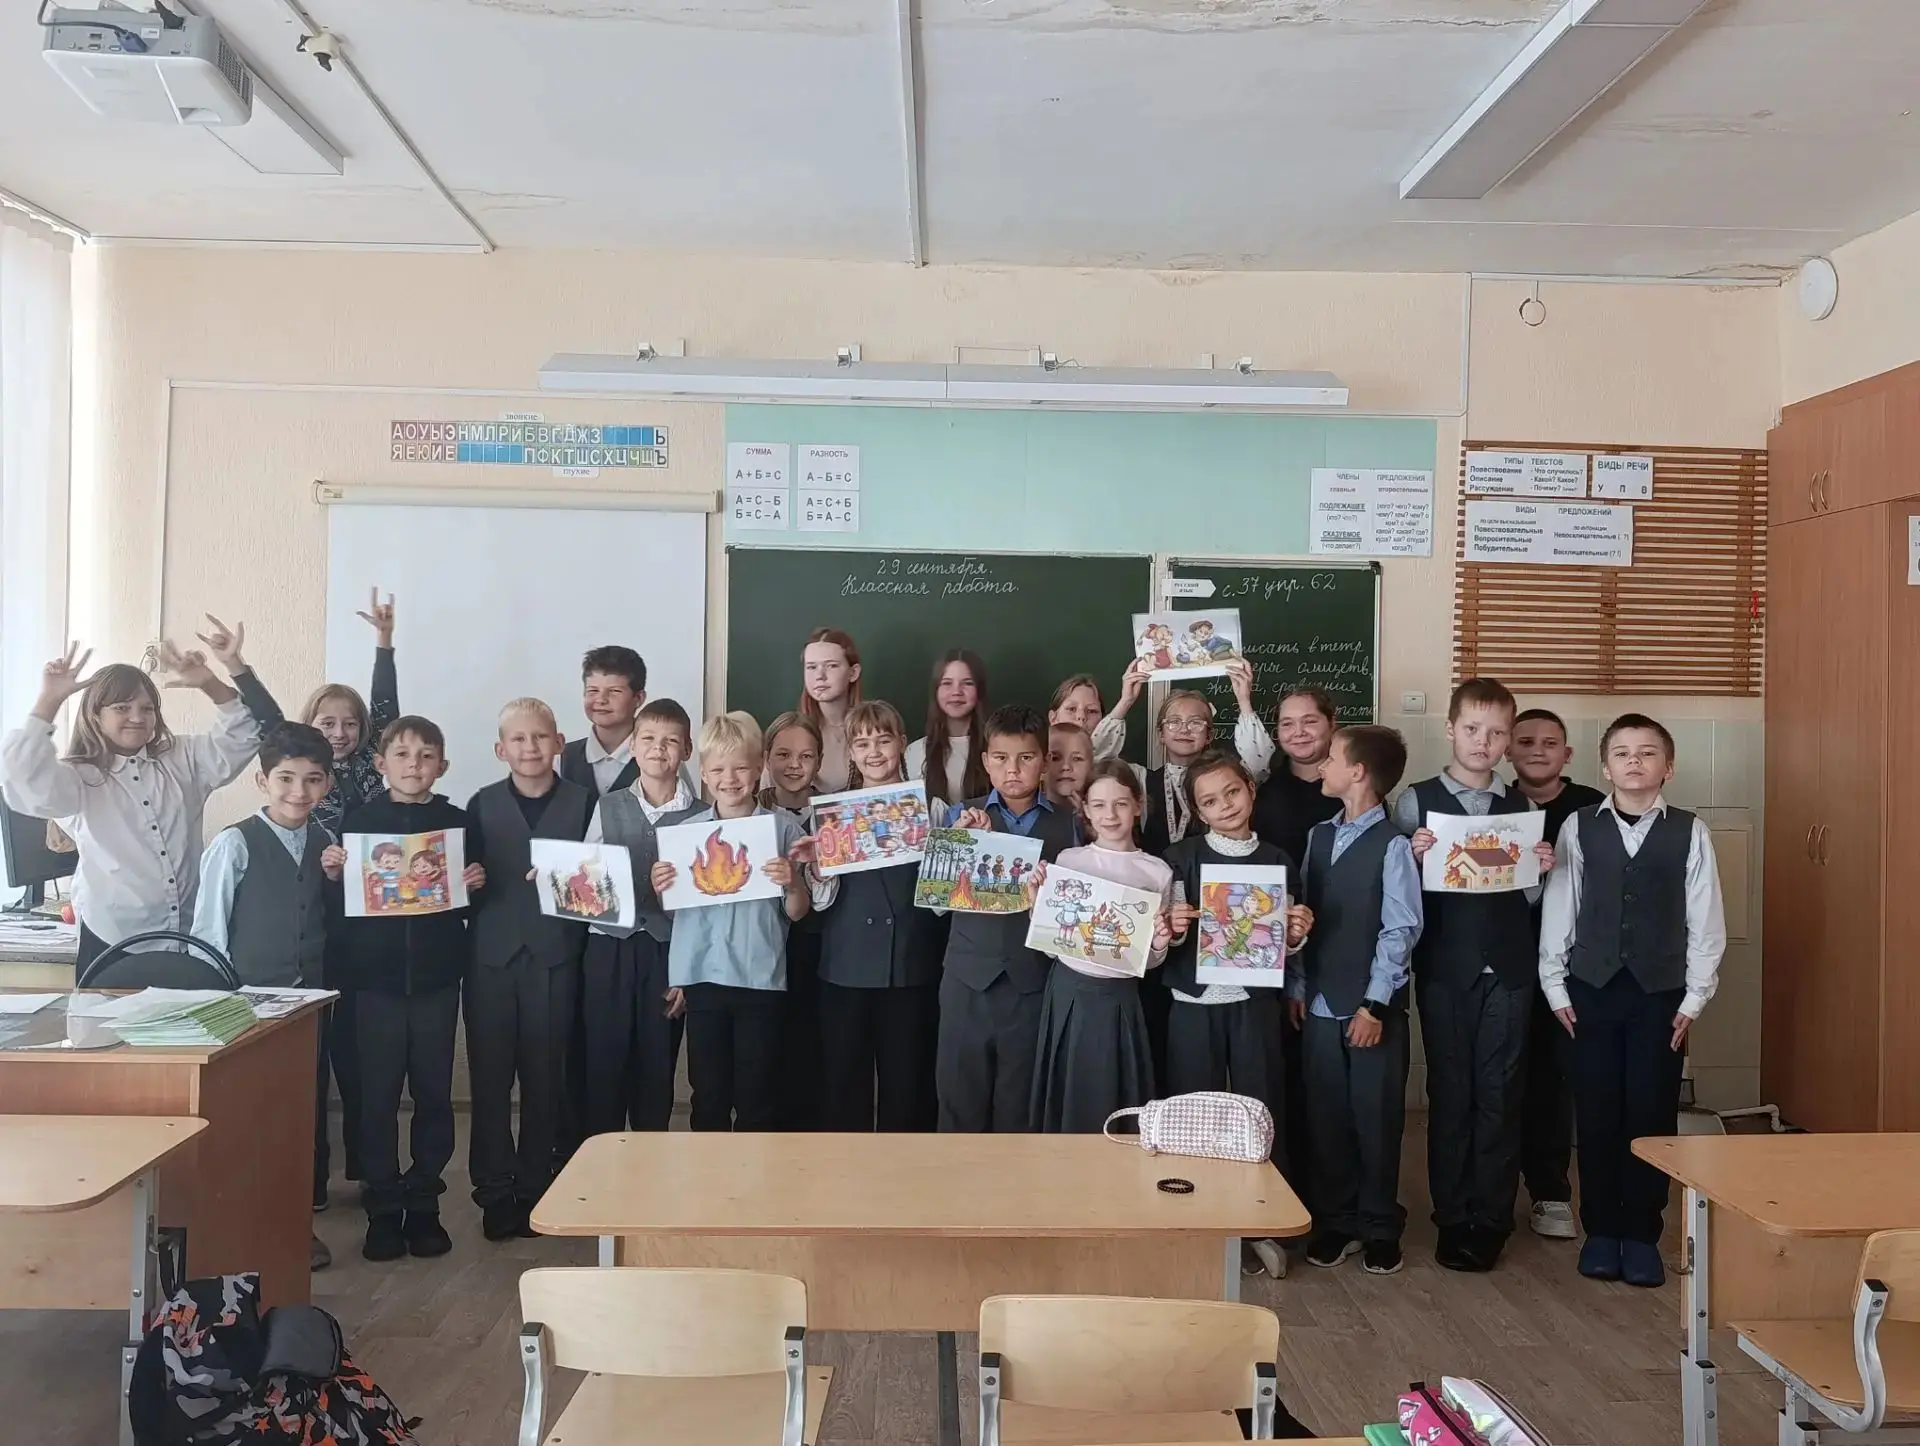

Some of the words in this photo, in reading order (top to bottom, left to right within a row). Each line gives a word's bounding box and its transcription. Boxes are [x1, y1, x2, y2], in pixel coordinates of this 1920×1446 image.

[746, 447, 772, 456] СУММА
[810, 450, 848, 458] РАЗНОСТЬ
[1470, 466, 1522, 474] Повествование
[1597, 460, 1624, 470] ВИДЫ
[1626, 462, 1649, 471] РЕЧИ
[1598, 484, 1604, 492] У
[1620, 484, 1626, 492] П
[1641, 486, 1648, 494] В
[1516, 506, 1536, 514] ВИДЫ
[1558, 507, 1612, 516] ПРЕДЛОЖЕНИЙ
[1474, 525, 1544, 534] Повествовательные
[1474, 534, 1532, 544] Вопросительные
[1474, 544, 1528, 552] Побудительные
[877, 559, 900, 576] 29
[841, 574, 930, 596] Классная
[941, 577, 1020, 600] работа.
[1264, 578, 1304, 602] упр.
[1311, 574, 1336, 590] 62
